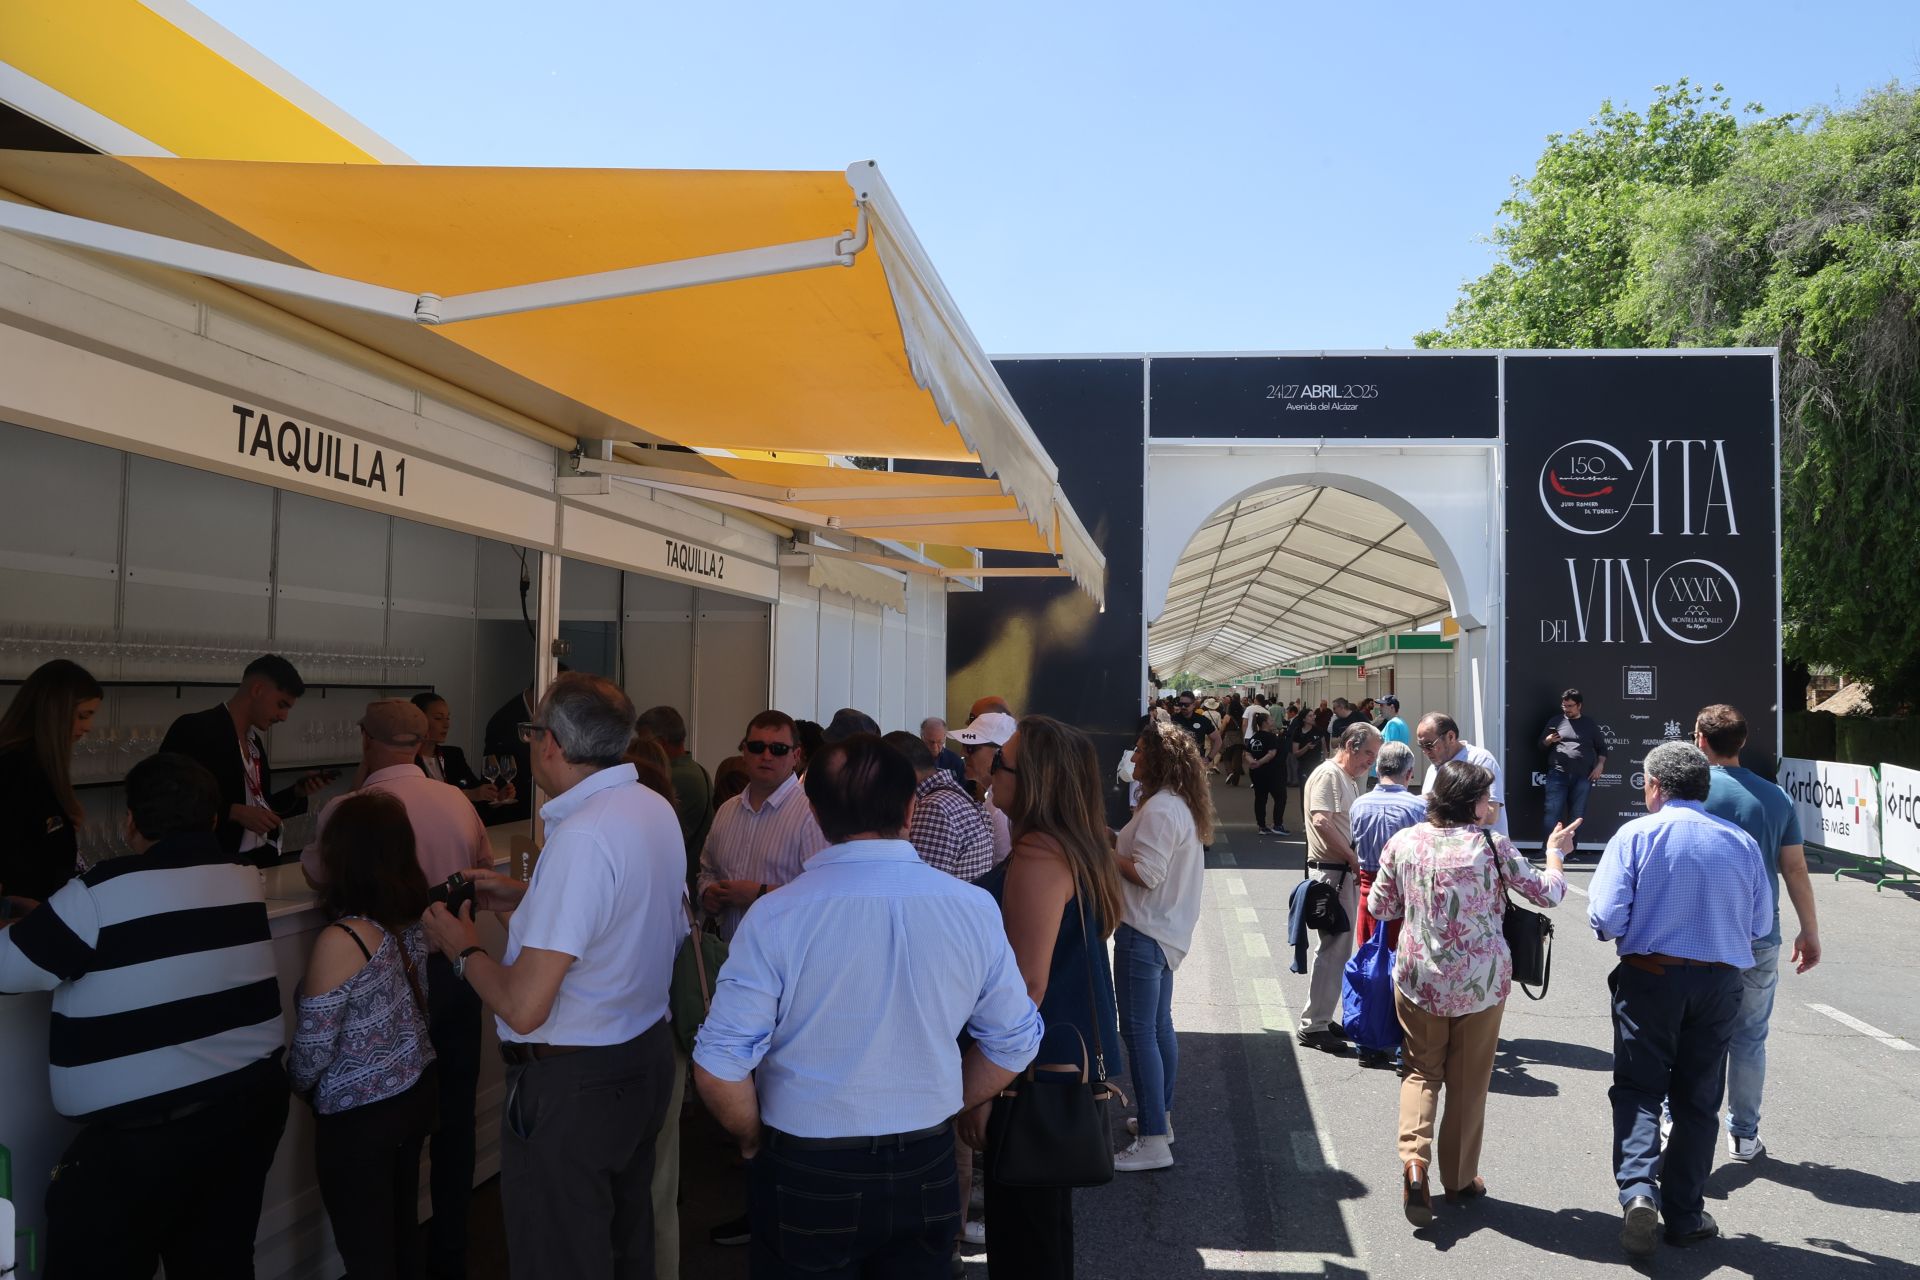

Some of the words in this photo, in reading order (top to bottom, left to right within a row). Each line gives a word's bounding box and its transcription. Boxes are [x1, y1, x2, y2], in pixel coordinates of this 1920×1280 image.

[1300, 384, 1342, 398] ABRIL
[1343, 384, 1379, 399] 2025
[1286, 402, 1317, 411] Avenida
[1318, 402, 1331, 411] del
[1331, 402, 1359, 411] Alcázar
[232, 404, 386, 493] TAQUILLA
[395, 457, 405, 497] 1
[1571, 456, 1606, 474] 150
[665, 539, 716, 578] TAQUILLA
[717, 555, 724, 580] 2
[1540, 619, 1574, 643] DEL
[1565, 558, 1741, 644] VINO
[1669, 577, 1722, 602] XXXIX
